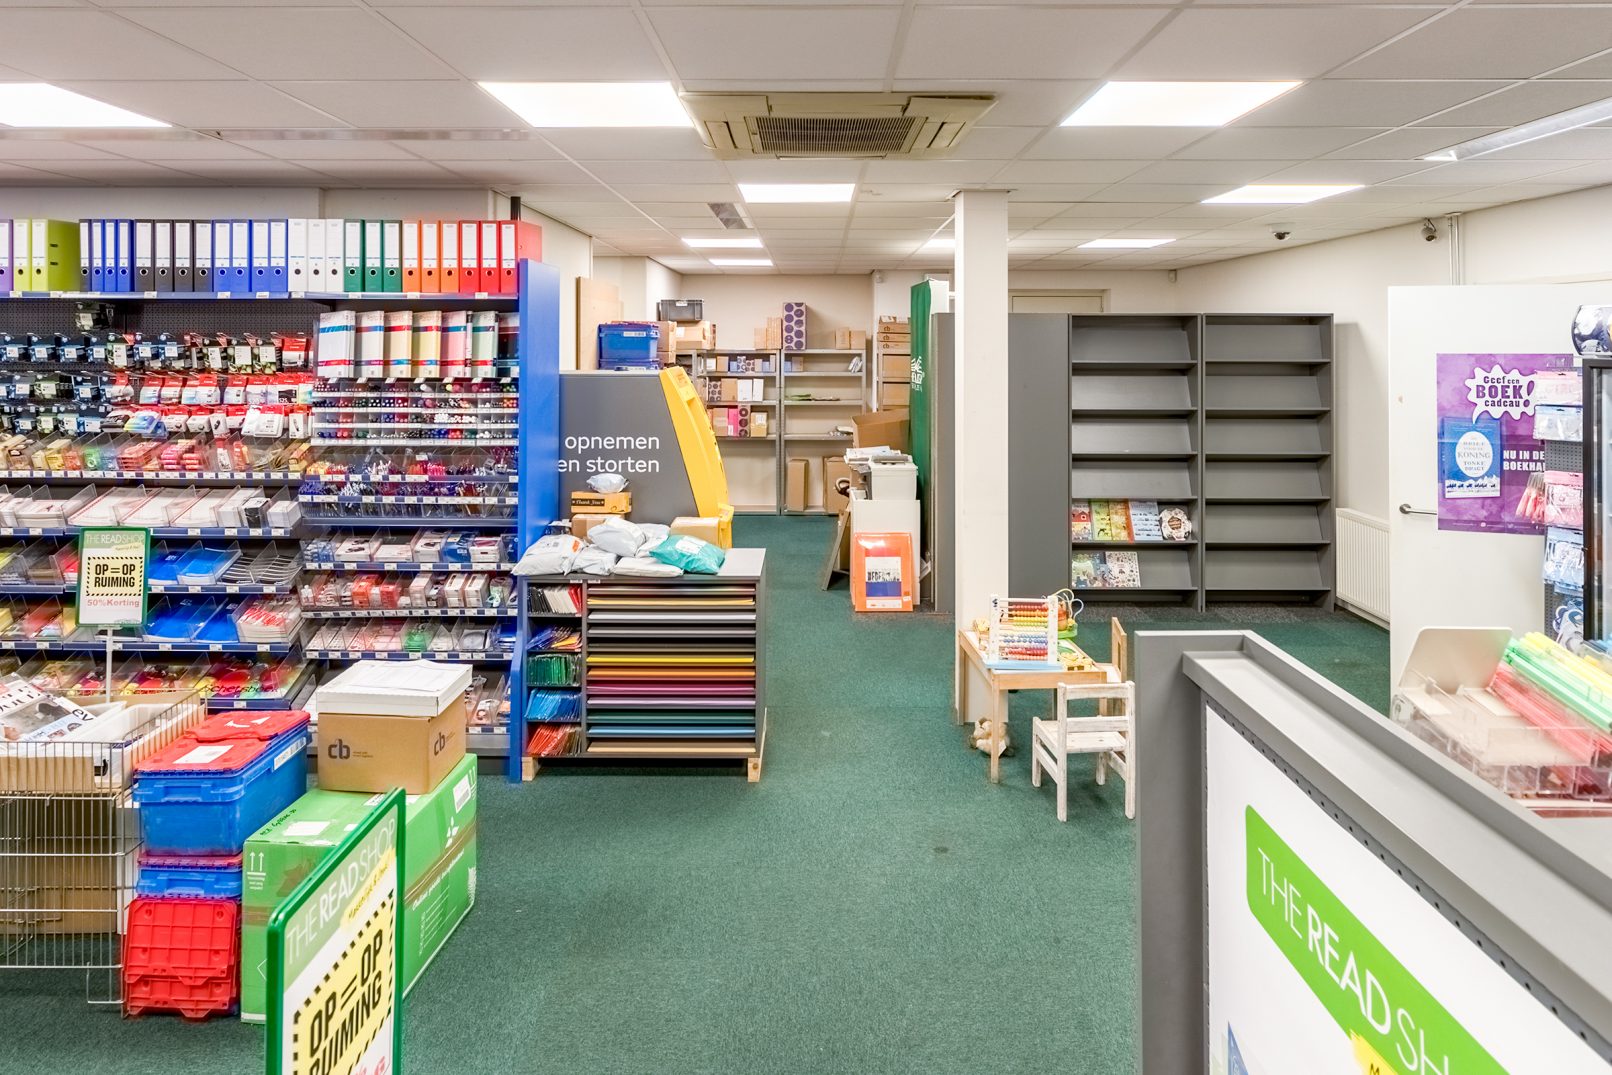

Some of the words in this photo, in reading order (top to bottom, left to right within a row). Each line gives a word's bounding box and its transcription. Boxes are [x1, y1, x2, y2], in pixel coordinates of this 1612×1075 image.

[1483, 375, 1506, 384] Geef
[1476, 384, 1524, 399] BOEK
[1484, 398, 1520, 408] cadeau
[564, 436, 660, 455] opnemen
[1457, 451, 1491, 459] KONING
[1503, 450, 1517, 460] NU
[1519, 450, 1530, 460] IN
[1532, 450, 1546, 460] DE
[558, 459, 580, 473] en
[586, 456, 660, 473] storten
[1503, 461, 1546, 471] BOEKHA
[85, 534, 100, 544] THE
[100, 534, 121, 544] READ
[121, 534, 145, 544] SHOP
[94, 576, 136, 588] RUIMING
[327, 738, 351, 760] cb
[433, 731, 446, 756] cb
[286, 903, 318, 965] THE
[319, 862, 359, 930] READ
[359, 818, 396, 882] SHOP
[1257, 847, 1303, 940] THE
[1306, 903, 1392, 1036] READ
